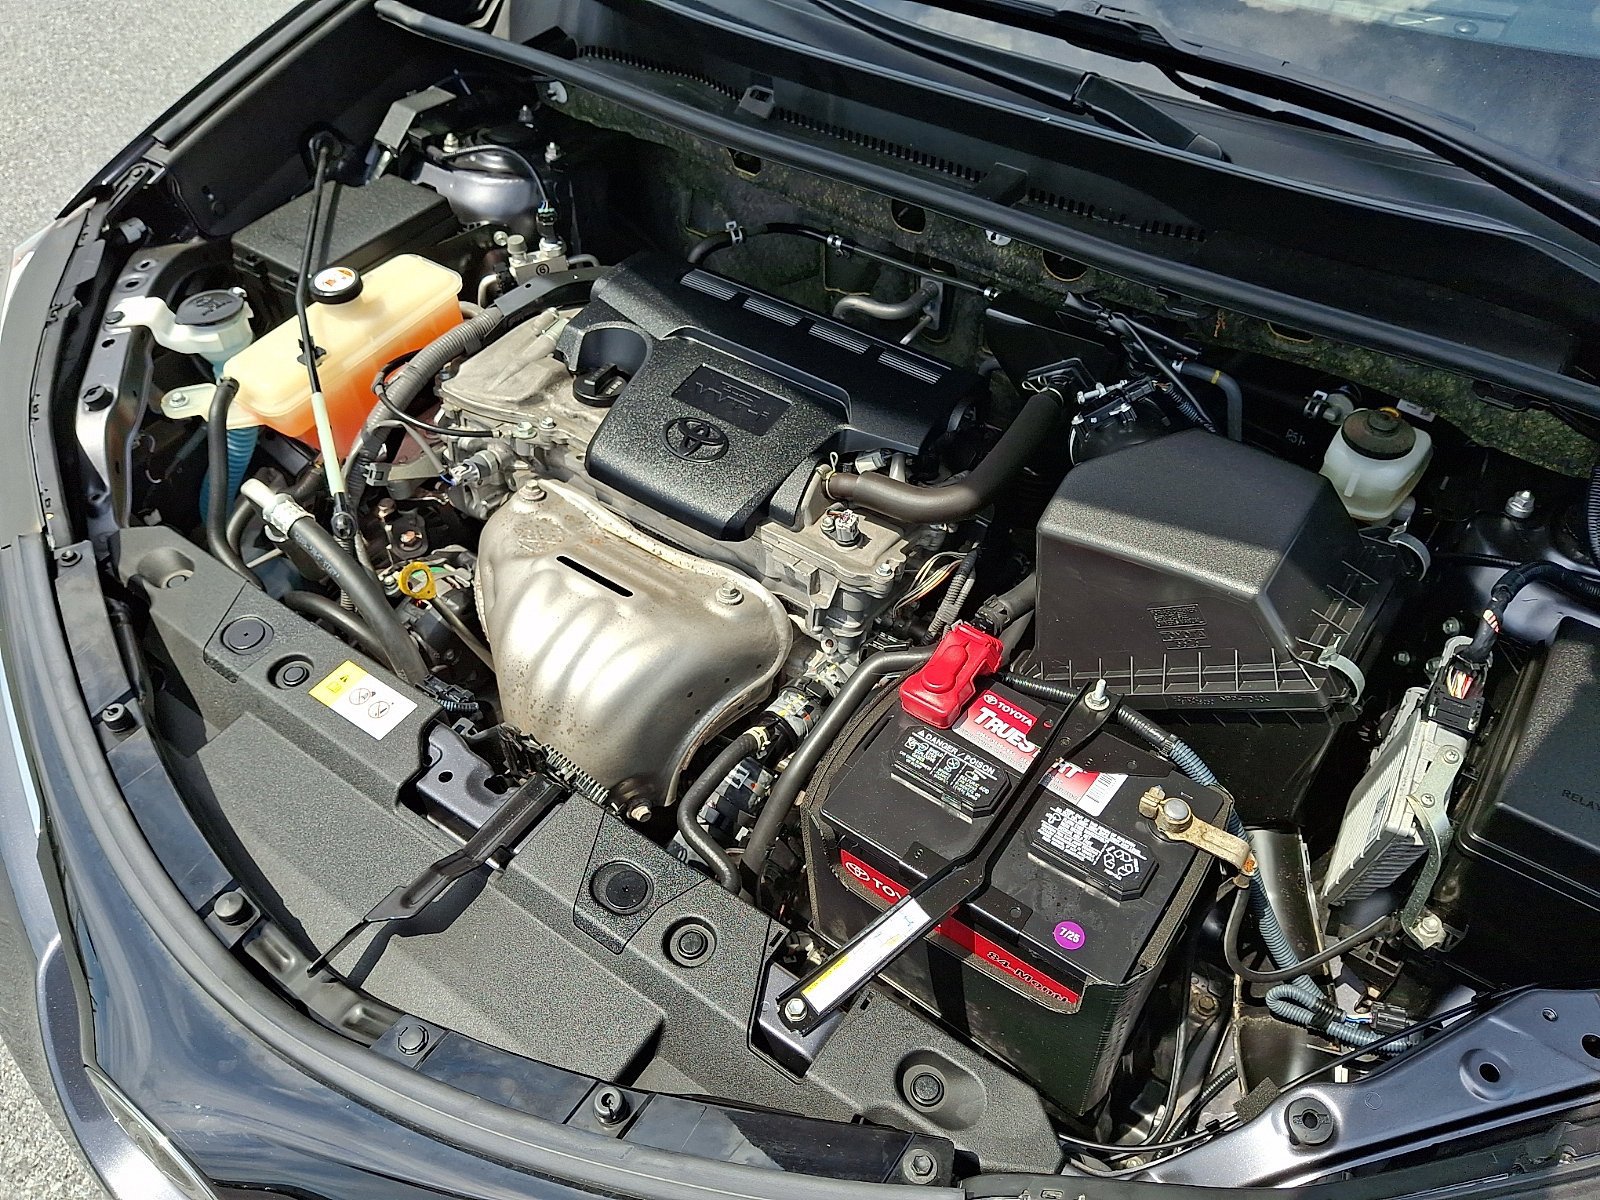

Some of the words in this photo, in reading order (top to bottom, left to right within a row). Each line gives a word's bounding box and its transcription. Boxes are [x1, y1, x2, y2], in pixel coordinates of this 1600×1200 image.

[998, 702, 1034, 727] TOYOTA
[924, 732, 958, 755] DANGER
[963, 753, 996, 775] POISON
[1059, 927, 1080, 943] 7/25
